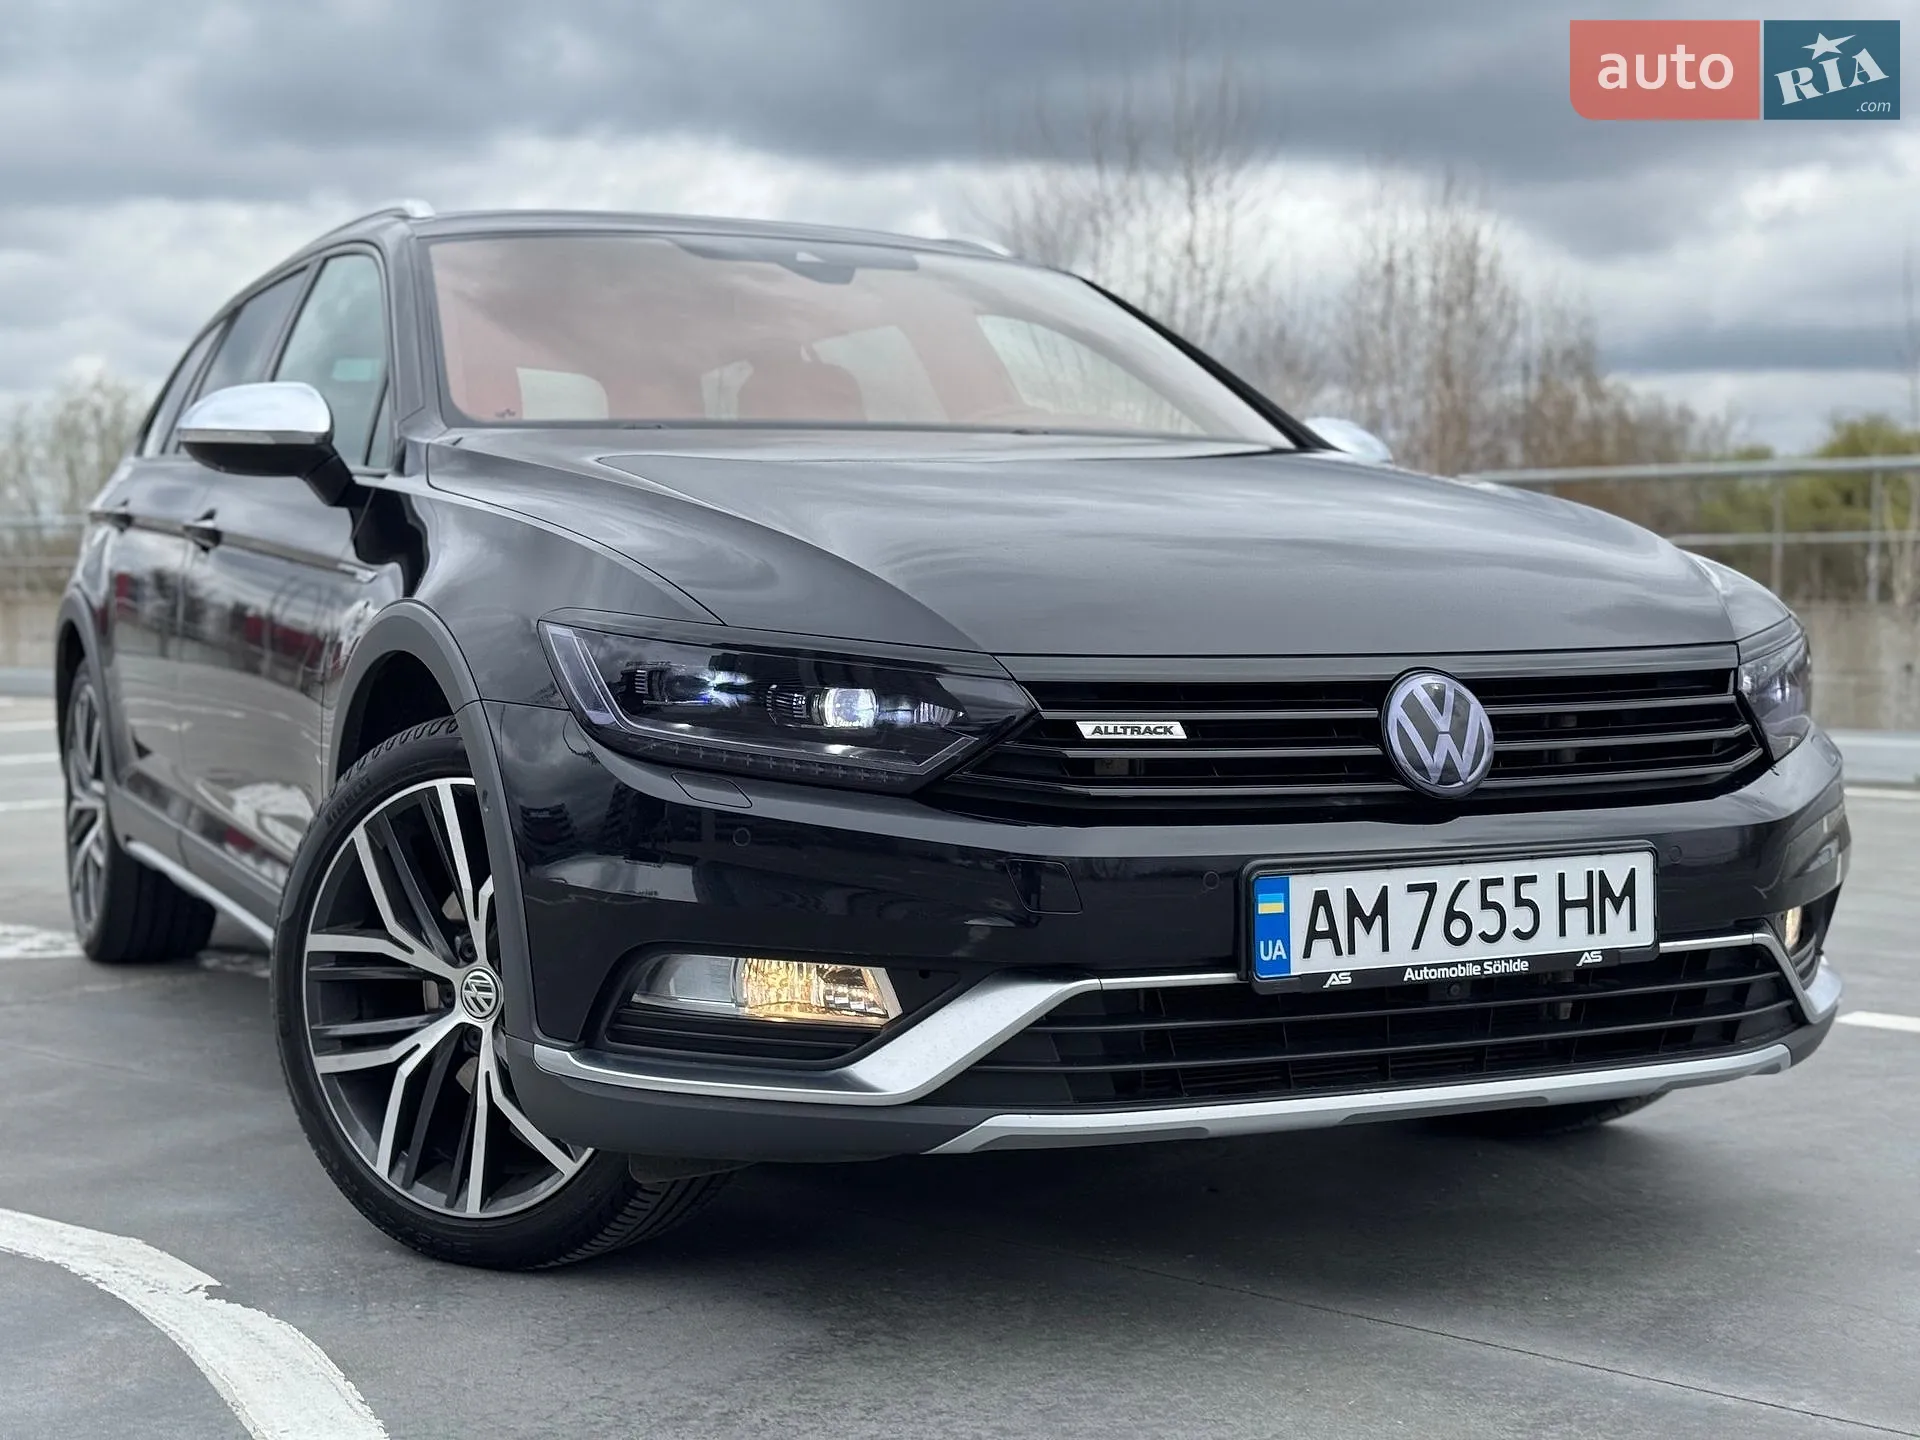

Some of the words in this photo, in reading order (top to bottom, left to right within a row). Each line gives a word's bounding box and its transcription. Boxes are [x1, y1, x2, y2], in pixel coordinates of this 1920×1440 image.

[1091, 725, 1175, 736] ALLTRACK
[1302, 885, 1390, 960] AM
[1405, 874, 1541, 951] 7655
[1557, 867, 1637, 937] HM
[1260, 940, 1287, 960] UA
[1576, 950, 1603, 967] AS
[1404, 963, 1481, 982] Automobile
[1483, 958, 1529, 975] Söhlde
[1322, 972, 1353, 988] AS
